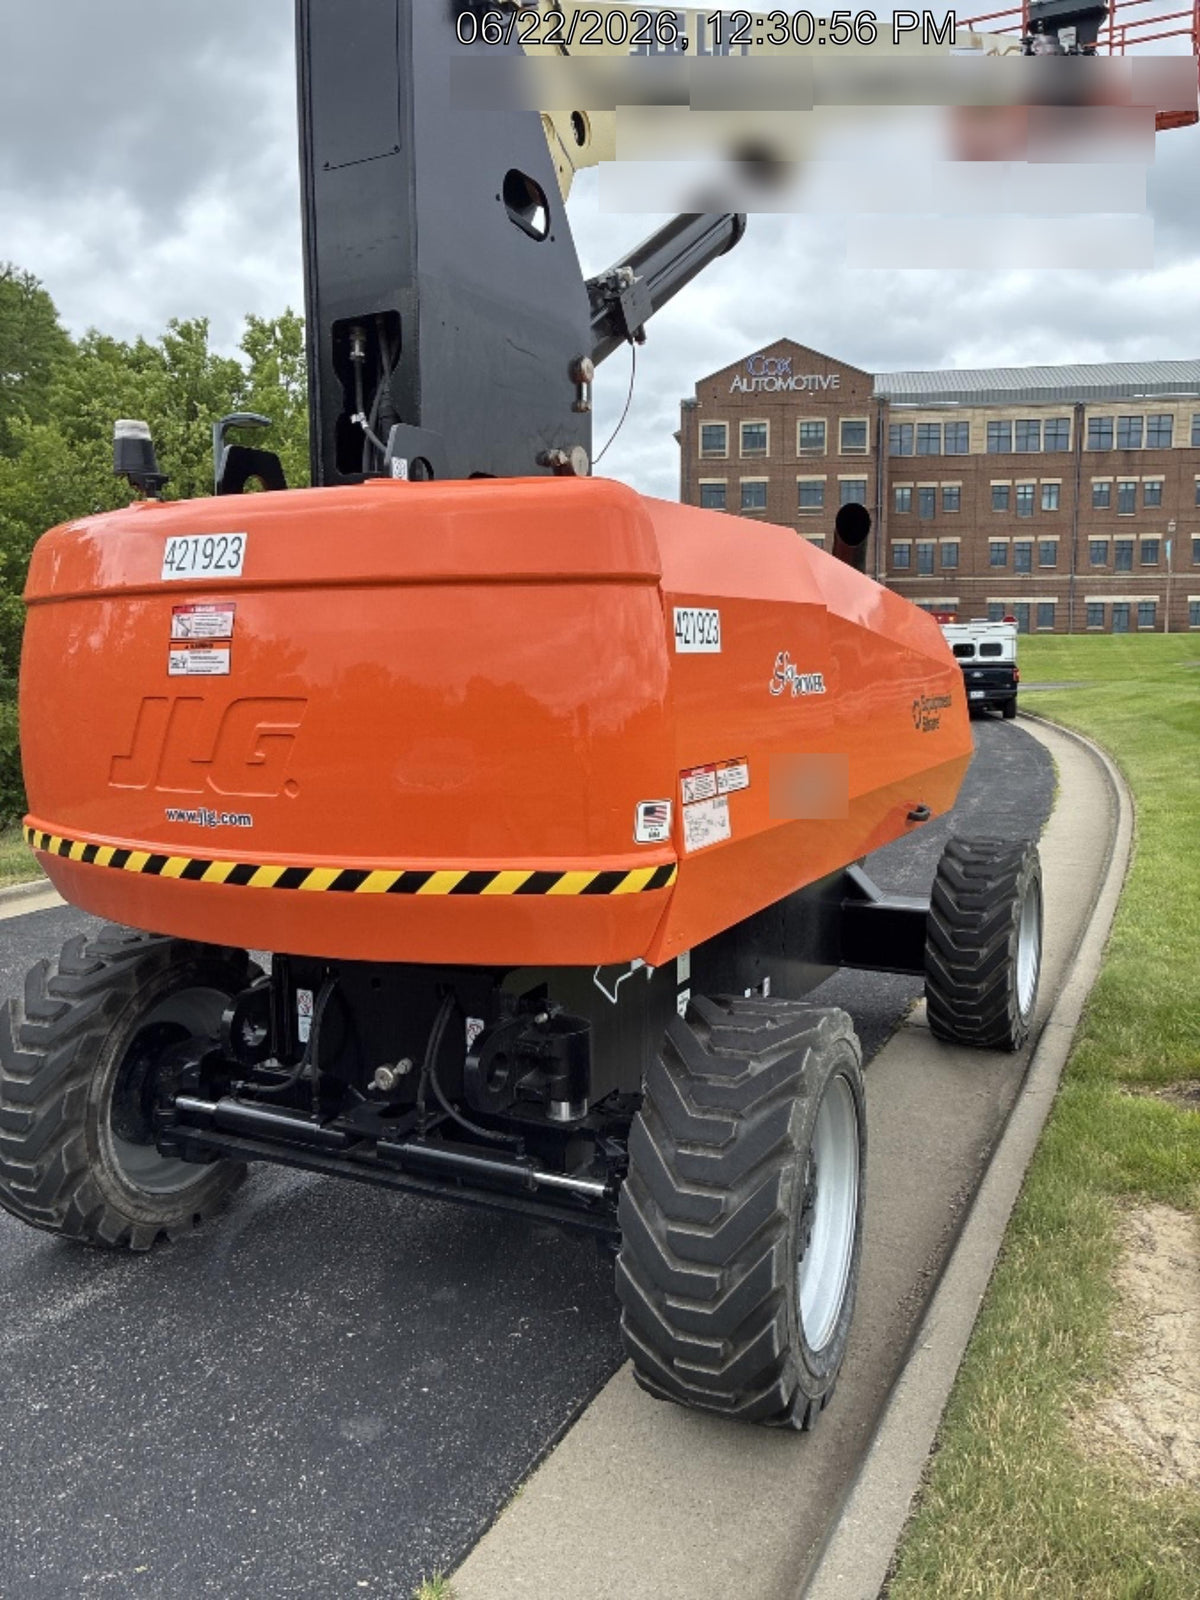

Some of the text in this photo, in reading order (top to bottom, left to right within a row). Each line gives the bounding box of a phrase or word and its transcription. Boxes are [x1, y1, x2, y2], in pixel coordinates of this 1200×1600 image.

[729, 374, 840, 393] AUTOMOTIVE
[164, 536, 243, 571] 421923
[675, 611, 719, 644] 421923
[165, 807, 253, 827] www.jlg.com
